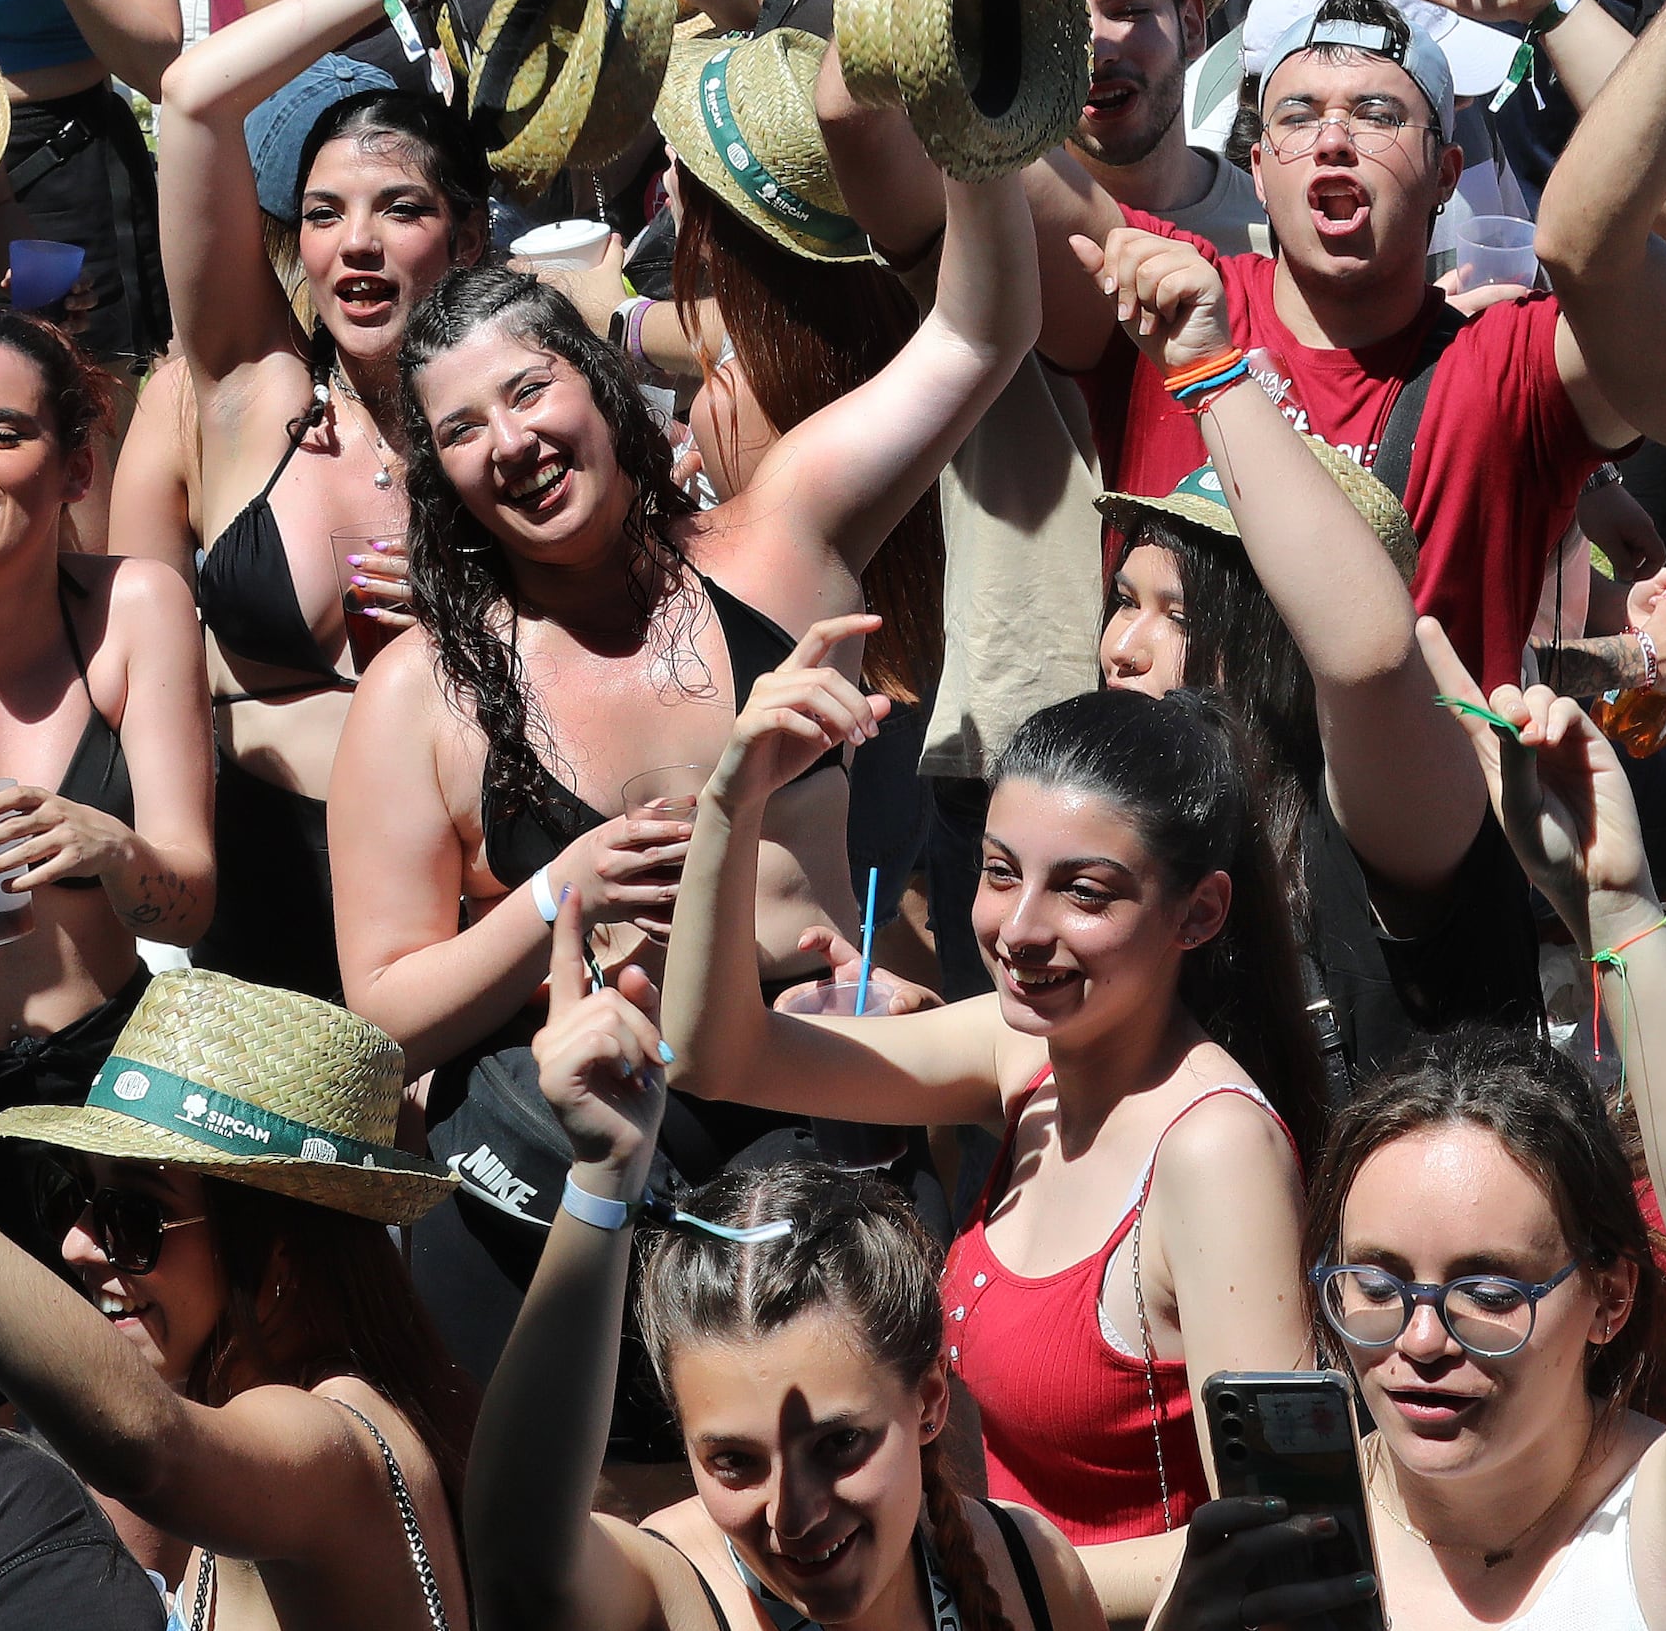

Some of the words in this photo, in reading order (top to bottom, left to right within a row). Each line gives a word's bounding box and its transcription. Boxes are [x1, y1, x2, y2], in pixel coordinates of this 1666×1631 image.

[708, 91, 724, 129] SIPCAM
[774, 194, 810, 223] SIPCAM
[206, 1108, 271, 1144] SIPCAM
[461, 1142, 540, 1213] NIKE
